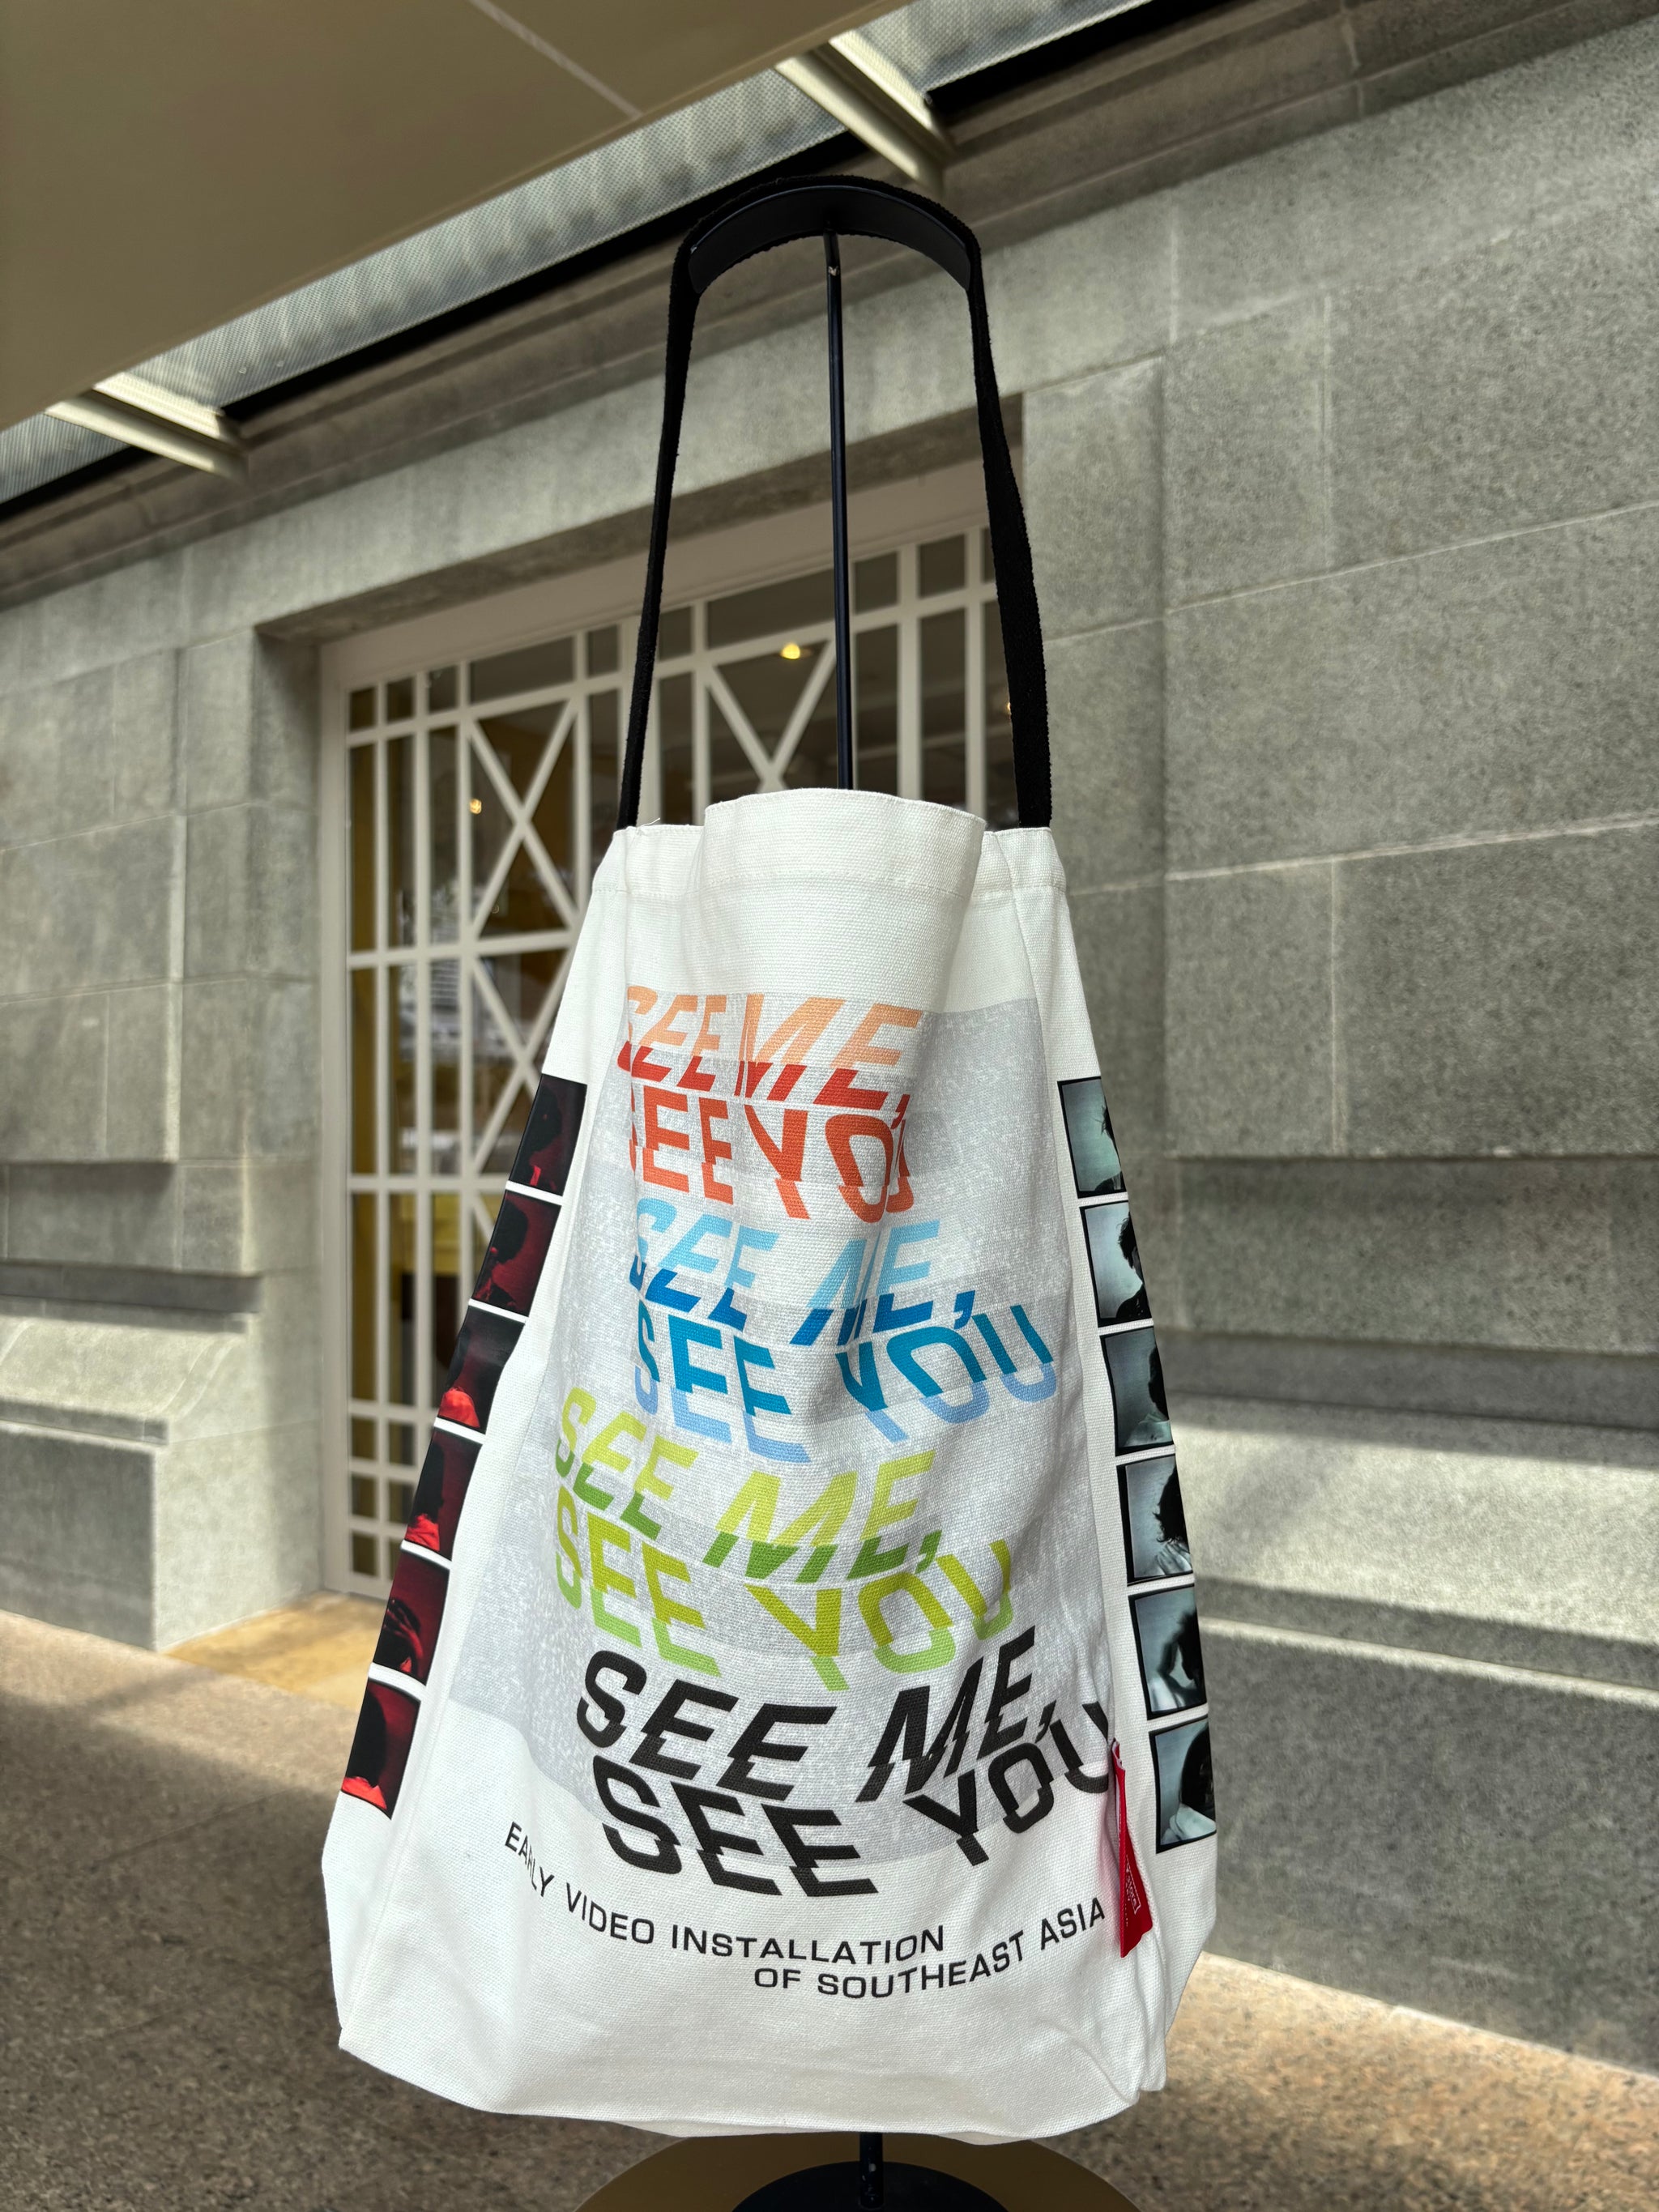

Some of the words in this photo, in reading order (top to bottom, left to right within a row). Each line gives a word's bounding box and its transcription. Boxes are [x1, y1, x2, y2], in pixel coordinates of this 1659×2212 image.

[629, 1198, 779, 1330] SEE
[635, 1299, 810, 1463] SEE
[835, 1305, 1056, 1442] YOU
[556, 1387, 699, 1540] SEE
[702, 1450, 942, 1583] ME,
[556, 1485, 723, 1677] SEE
[745, 1539, 1013, 1691] YOU
[576, 1649, 836, 1801] SEE
[855, 1626, 1056, 1803] ME,
[592, 1754, 879, 1897] SEE
[902, 1700, 1109, 1866] YOU
[566, 1882, 655, 1945] VIDEO
[672, 1924, 944, 1965] INSTALLATION
[754, 1967, 801, 1988] OF
[817, 1930, 1025, 1999] SOUTHEAST
[1040, 1897, 1106, 1951] ASIA
